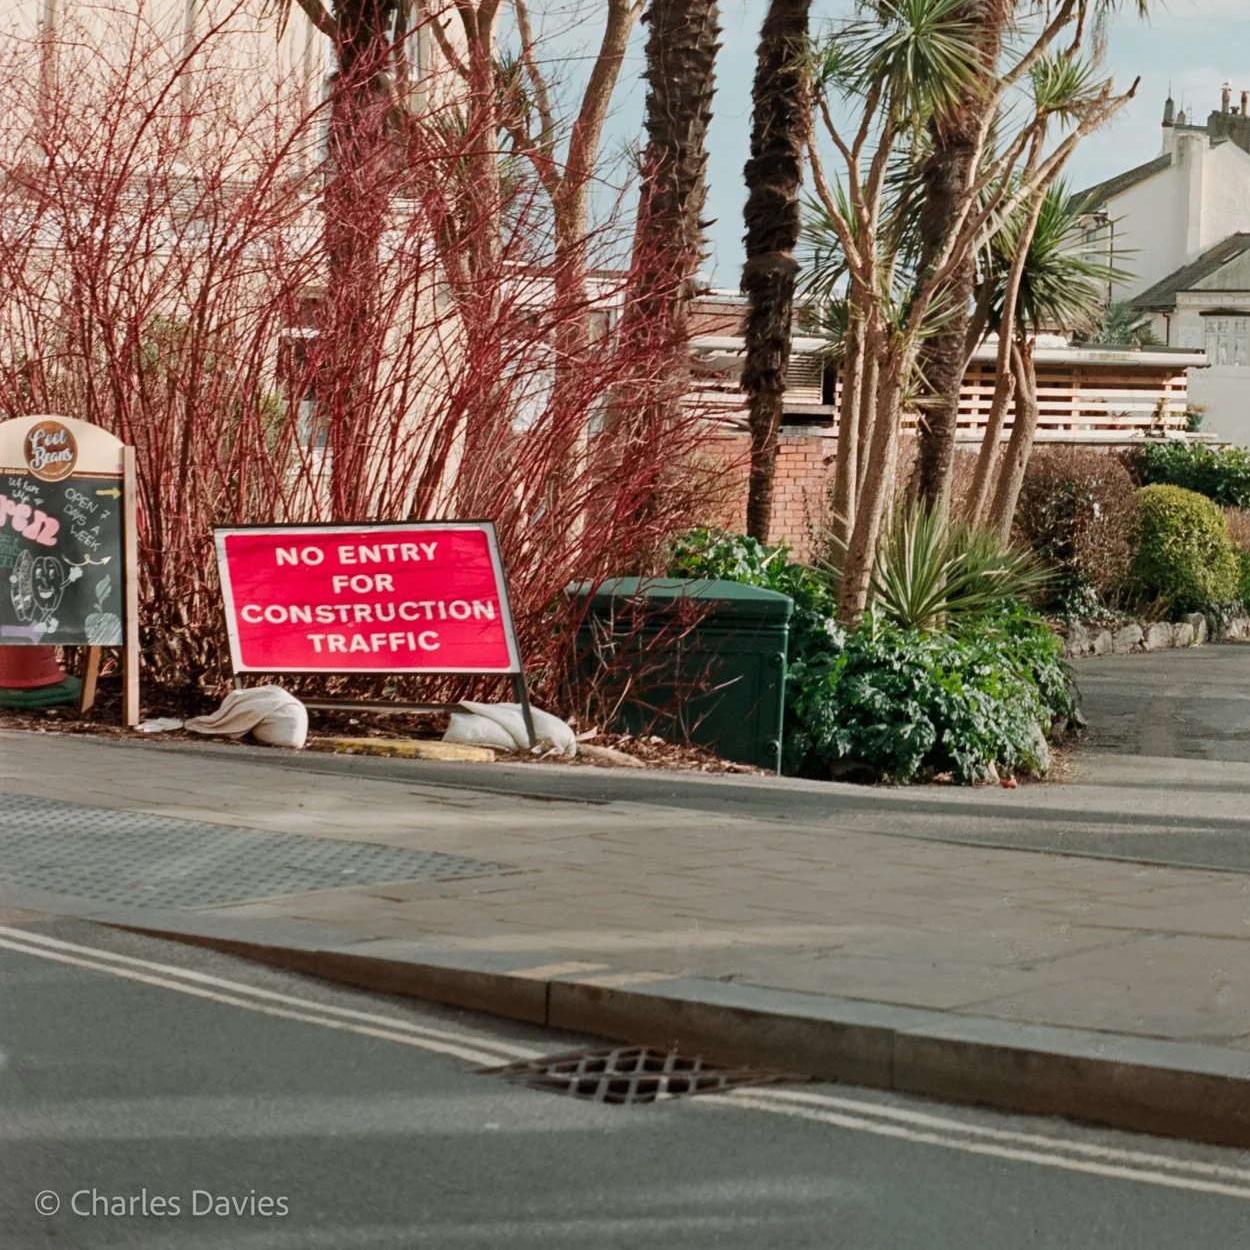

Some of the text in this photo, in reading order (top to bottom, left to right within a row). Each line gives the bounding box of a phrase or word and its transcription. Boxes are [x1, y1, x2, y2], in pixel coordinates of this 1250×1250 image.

[29, 429, 67, 449] Cool
[30, 447, 73, 471] Beans
[65, 488, 99, 514] OPEN
[63, 505, 88, 527] DAYS
[70, 524, 103, 553] WEEK
[276, 543, 437, 565] NO ENTRY
[333, 574, 394, 593] FOR
[241, 600, 495, 623] CONSTRUCTION
[307, 630, 440, 653] TRAFFIC
